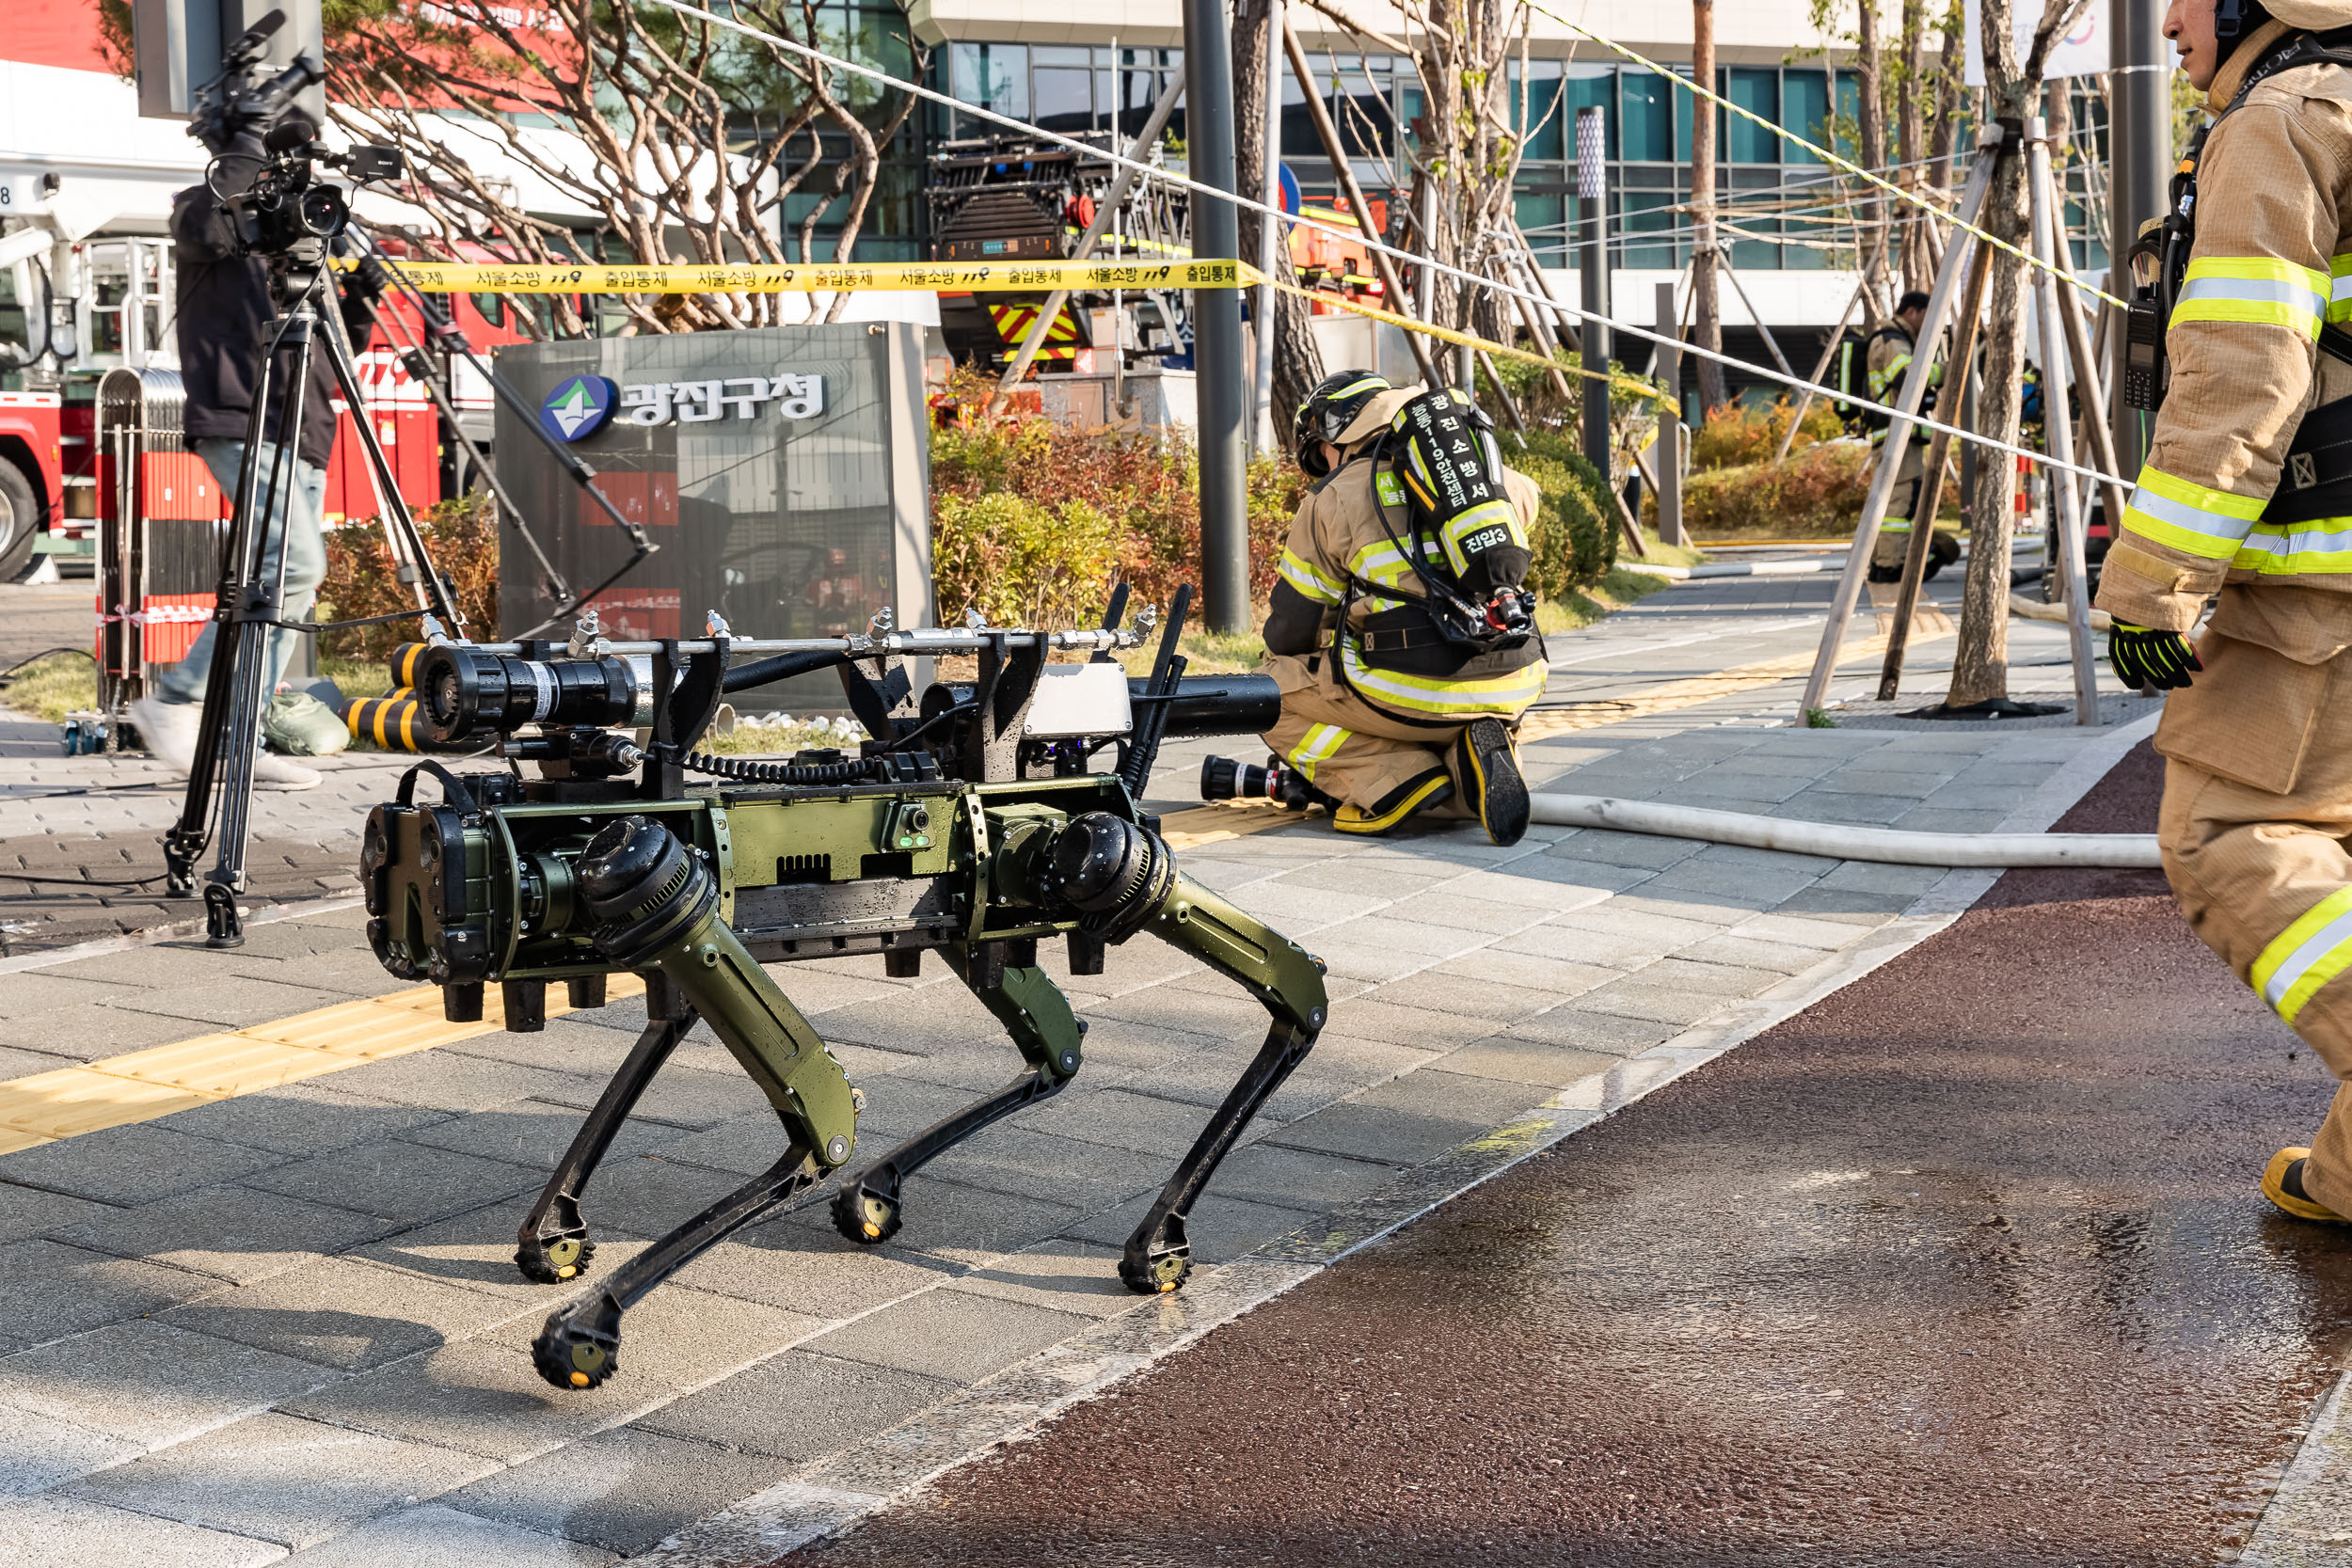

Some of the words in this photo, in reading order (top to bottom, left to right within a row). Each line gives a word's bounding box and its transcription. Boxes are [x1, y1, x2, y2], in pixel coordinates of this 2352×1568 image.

[388, 269, 443, 286] 입통제
[476, 271, 541, 288] 서울소방
[548, 269, 582, 287] 119
[604, 269, 669, 288] 출입통제
[697, 269, 756, 287] 서울소방
[763, 269, 795, 287] 119
[815, 269, 873, 287] 출입통제
[899, 268, 955, 286] 서울소방
[960, 266, 991, 285] 119
[1008, 267, 1062, 285] 출입통제
[1086, 266, 1138, 284] 서울소방
[1142, 264, 1170, 283] 119
[1185, 264, 1236, 283] 출입통제
[620, 372, 824, 427] 광진구청
[1411, 403, 1468, 508] 능동119안전센터
[1465, 528, 1507, 554] 진압3
